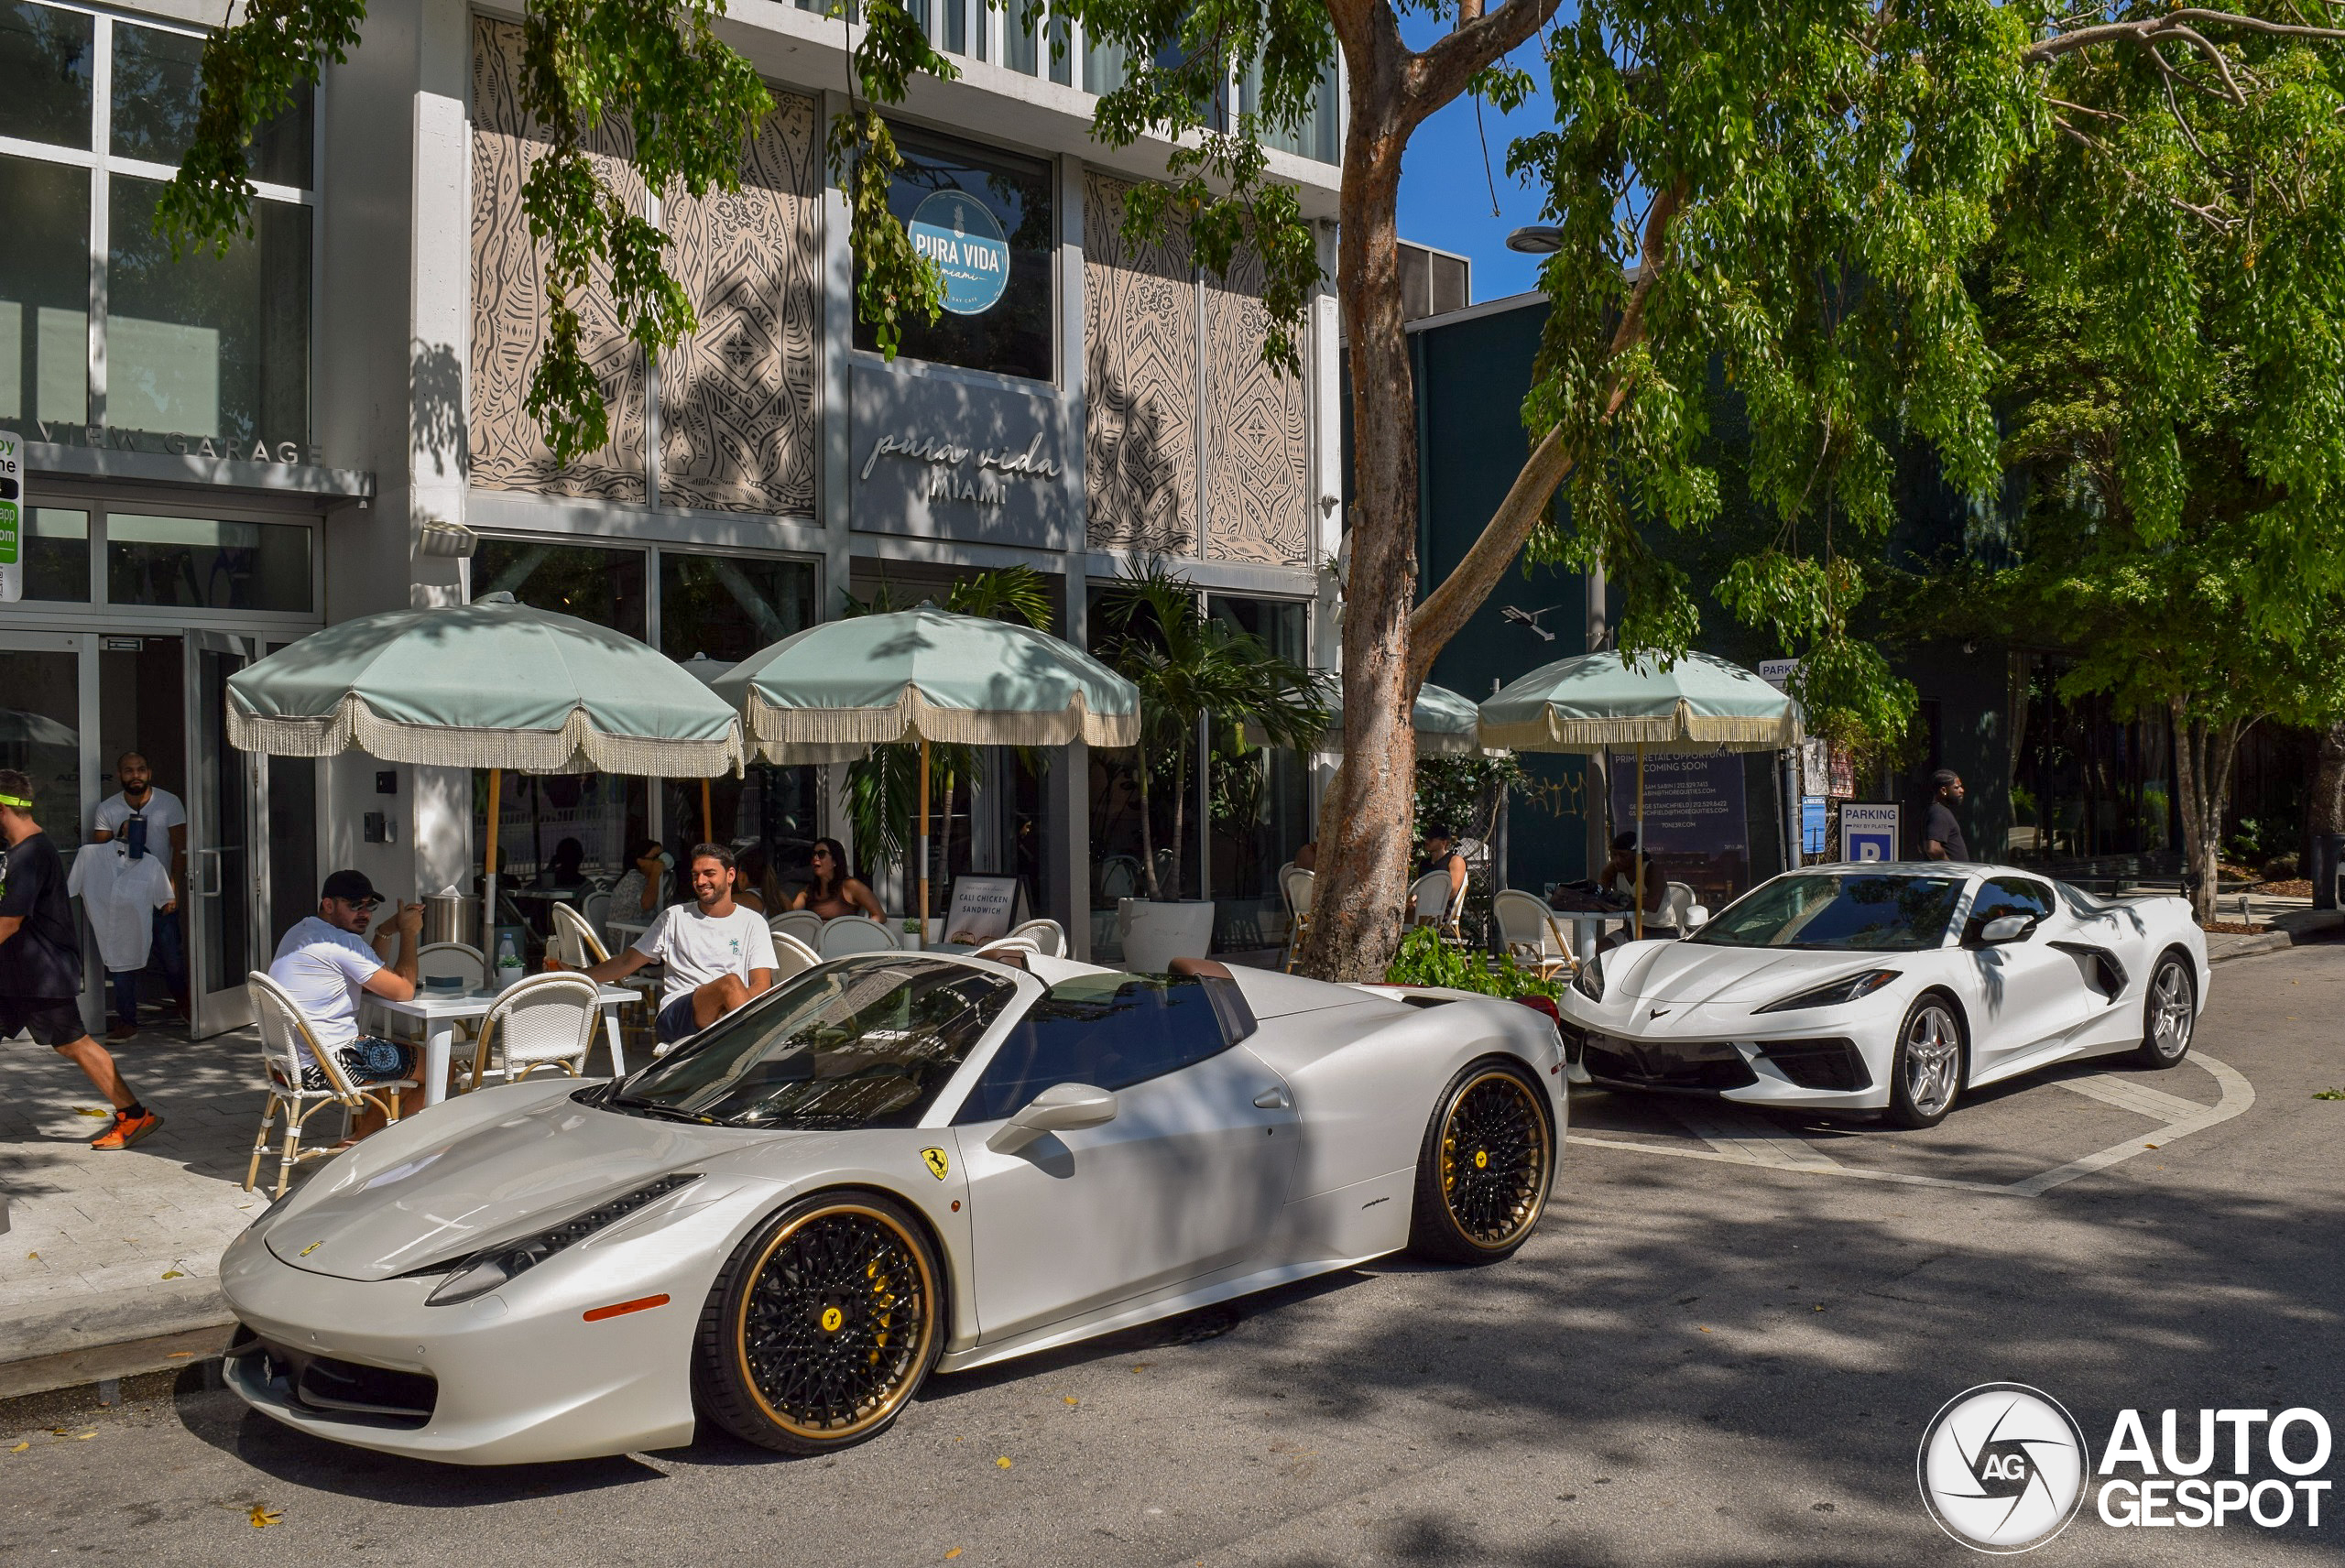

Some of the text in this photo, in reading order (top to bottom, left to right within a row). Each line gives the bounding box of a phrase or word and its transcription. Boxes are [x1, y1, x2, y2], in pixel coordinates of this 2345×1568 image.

[916, 234, 999, 273] PURA VIDA
[940, 267, 979, 281] miami
[36, 418, 144, 451] VIEW
[163, 431, 322, 468] GARAGE
[860, 431, 1063, 480] pura vida
[929, 474, 1006, 504] MIAMI
[1642, 753, 1671, 763] RETAIL
[1642, 761, 1707, 773] COMING SOON
[1629, 801, 1652, 811] GERGE
[1845, 809, 1896, 821] PARKING
[1860, 842, 1881, 861] P
[959, 893, 1008, 903] CALI CHICKEN
[962, 905, 1001, 915] SANDWICH
